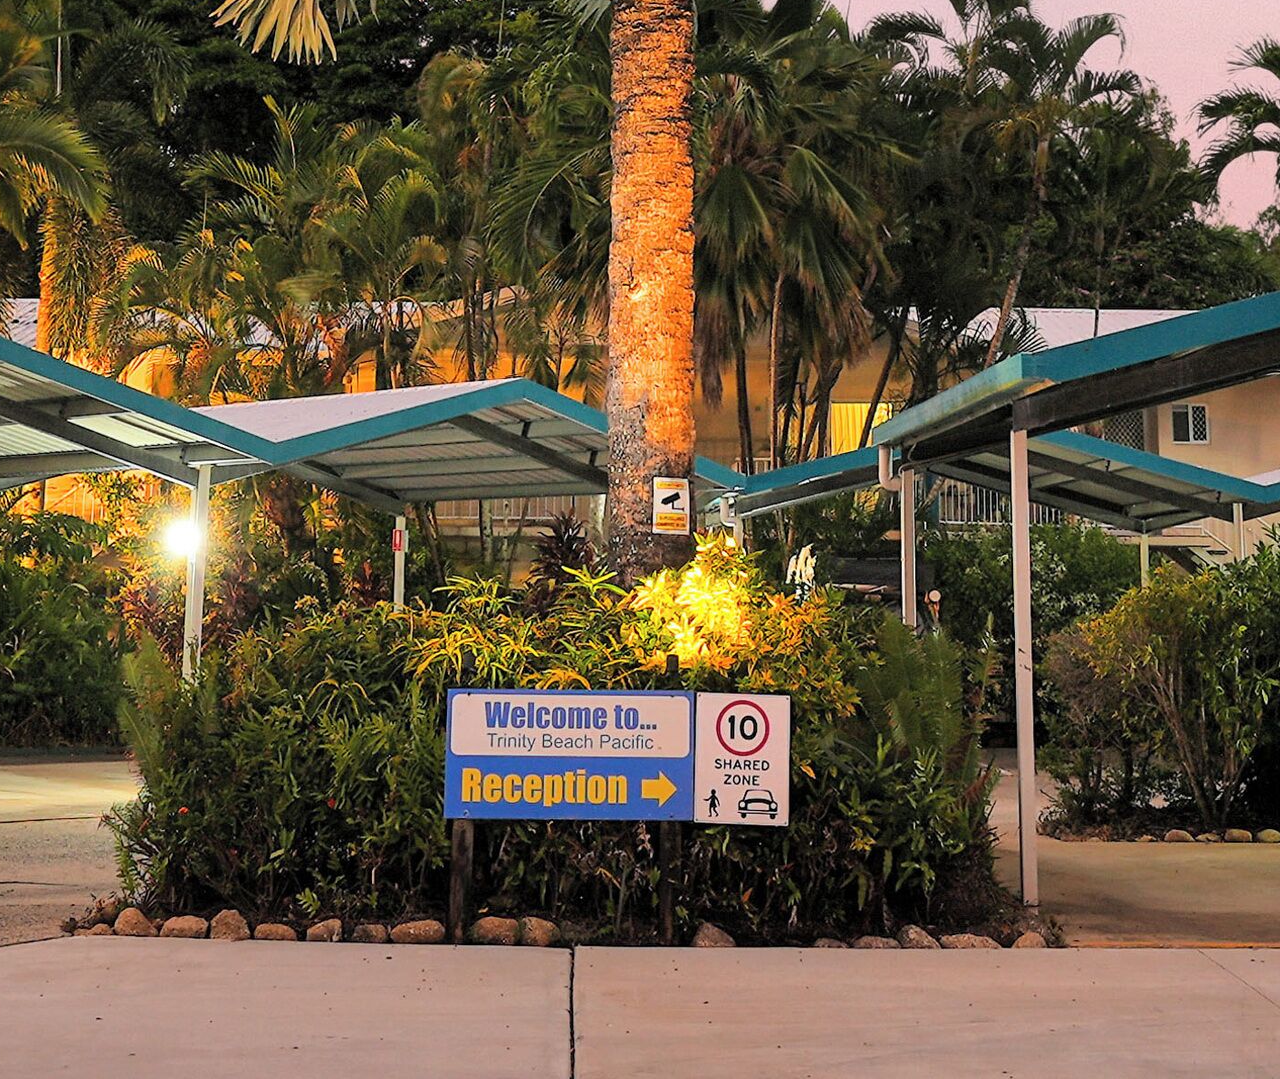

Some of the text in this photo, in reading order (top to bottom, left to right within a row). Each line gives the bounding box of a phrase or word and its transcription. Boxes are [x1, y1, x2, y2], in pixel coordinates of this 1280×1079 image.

[484, 701, 658, 730] Welcome to...
[728, 715, 758, 740] 10
[487, 732, 654, 752] Trinity Beach Pacific
[714, 758, 770, 771] SHARED
[461, 767, 628, 807] Reception
[723, 773, 760, 786] ZONE
